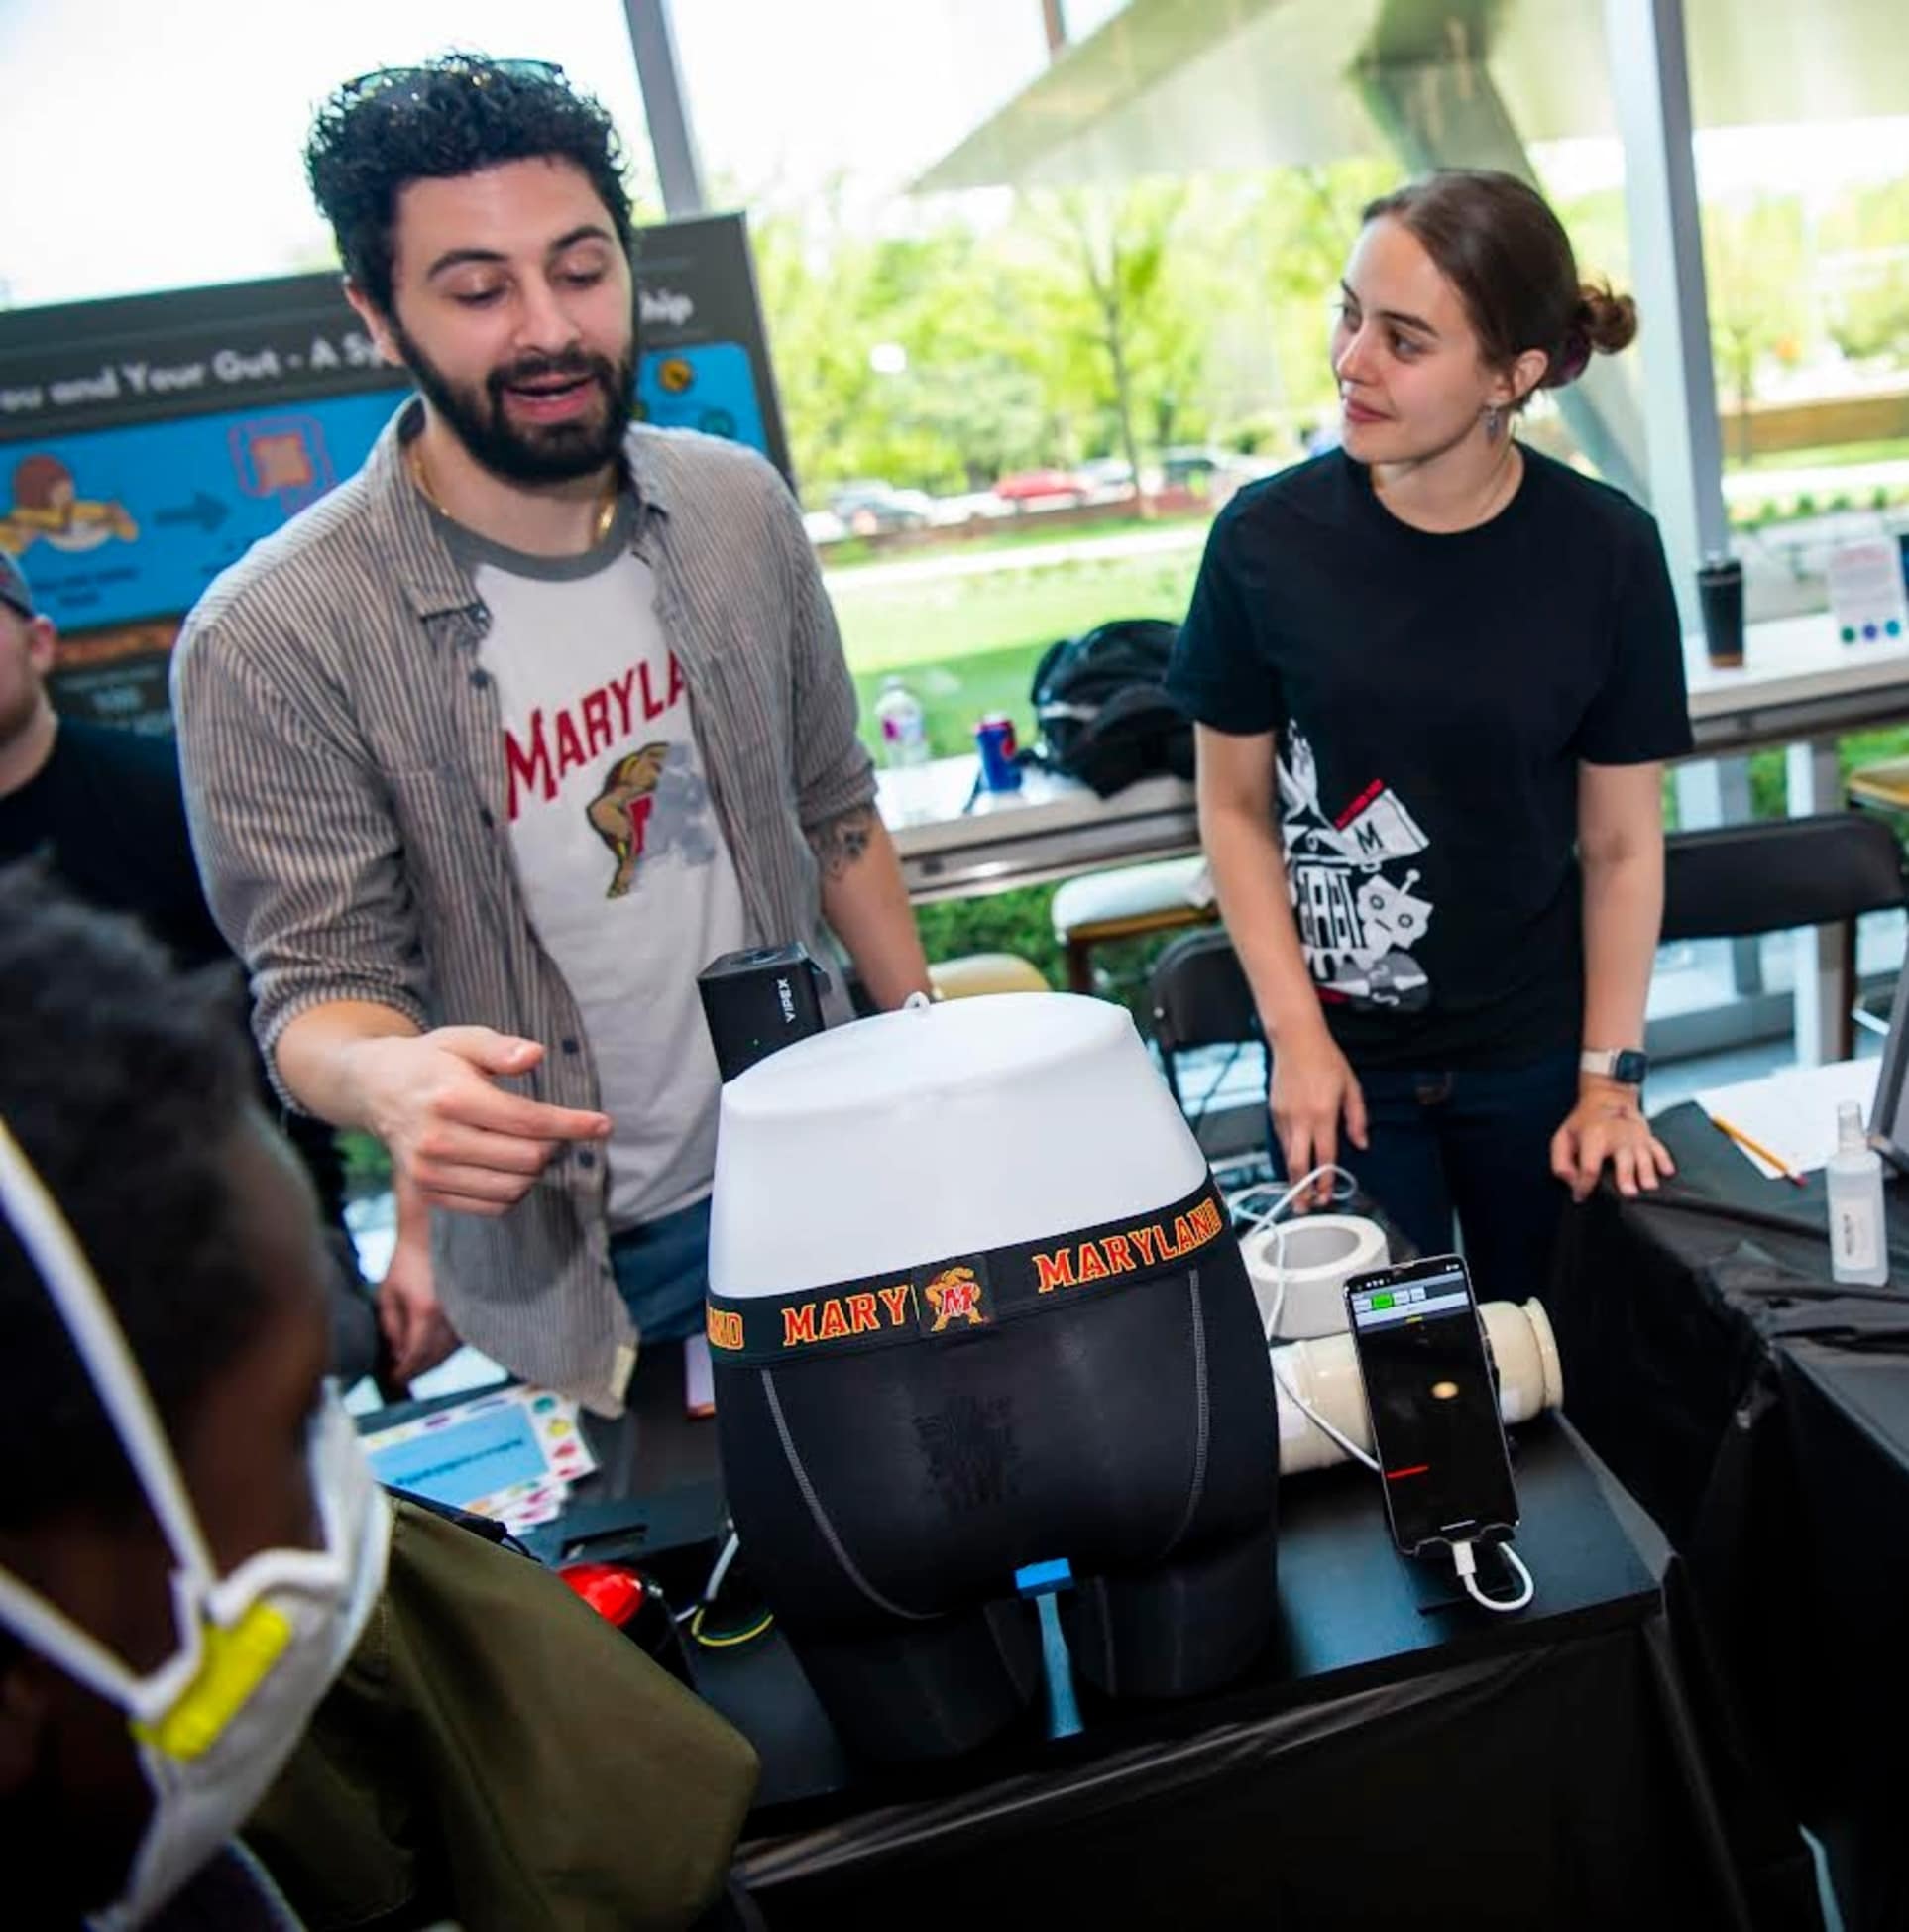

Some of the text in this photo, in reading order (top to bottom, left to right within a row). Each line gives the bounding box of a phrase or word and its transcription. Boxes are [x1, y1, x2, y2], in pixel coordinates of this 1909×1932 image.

[49, 366, 119, 404] and
[121, 362, 205, 394] Your
[211, 349, 281, 382] Gut
[310, 337, 339, 370] A
[1355, 820, 1384, 854] M
[1032, 1197, 1222, 1293] MARYLAND
[781, 1285, 909, 1347] MARY
[942, 1282, 975, 1316] M
